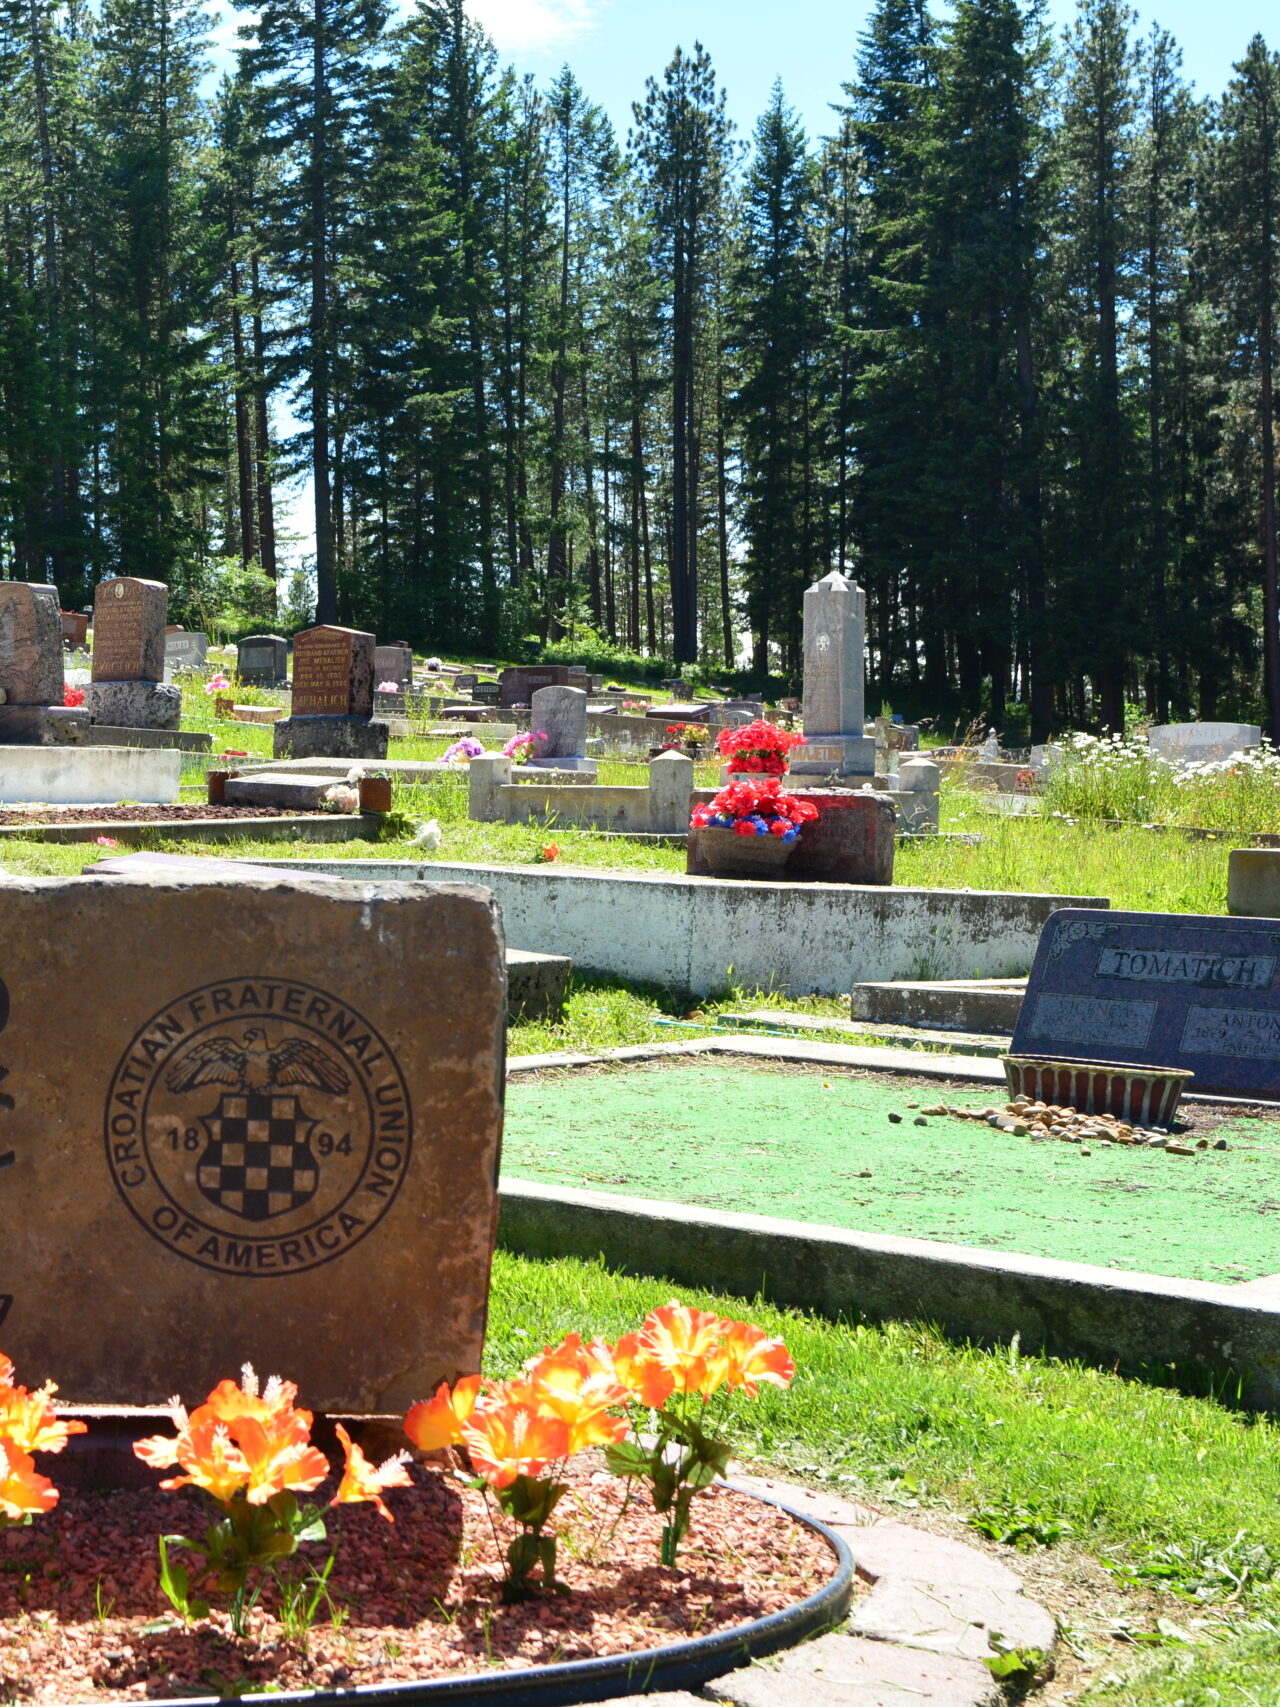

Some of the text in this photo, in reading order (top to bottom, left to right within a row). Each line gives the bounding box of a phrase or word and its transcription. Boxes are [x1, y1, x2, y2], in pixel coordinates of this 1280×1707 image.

[294, 695, 348, 707] MEHALICH
[1113, 952, 1257, 982] TOMATICH
[111, 984, 405, 1198] CROATIAN FRATERNAL UNION
[167, 1127, 353, 1157] 18 94
[152, 1205, 366, 1269] OF AMERICA
